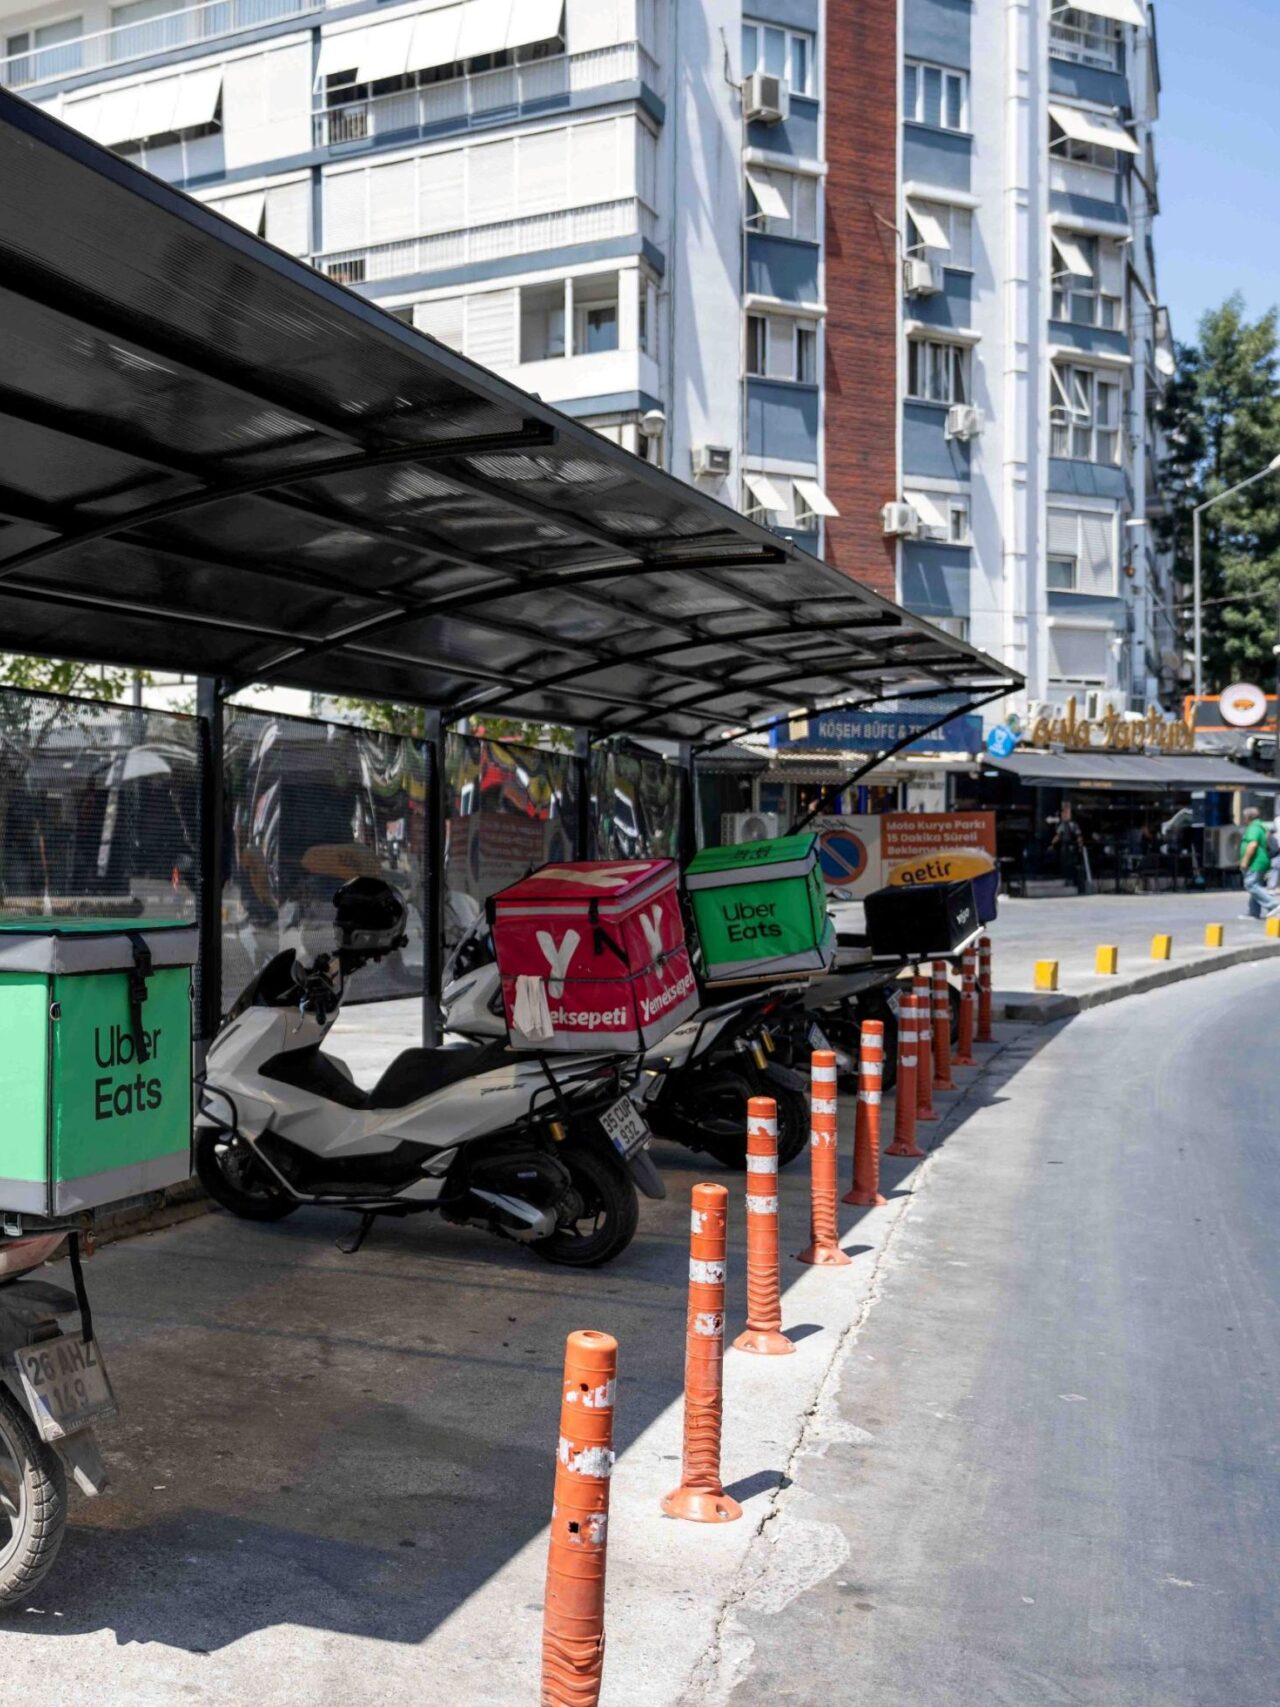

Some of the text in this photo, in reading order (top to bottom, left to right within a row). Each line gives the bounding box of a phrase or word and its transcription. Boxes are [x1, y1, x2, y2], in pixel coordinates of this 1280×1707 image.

[864, 720, 896, 740] BÜFE
[886, 821, 916, 831] Moto
[917, 821, 953, 833] Kurye
[887, 833, 897, 842] 15
[900, 832, 942, 843] Dakika
[901, 860, 952, 884] getir
[722, 902, 777, 921] Uber
[727, 921, 783, 943] Eats
[94, 1024, 162, 1069] Uber
[94, 1073, 162, 1121] Eats
[602, 1098, 632, 1134] 35 CUP
[619, 1120, 640, 1145] 932
[27, 1351, 56, 1386] 26
